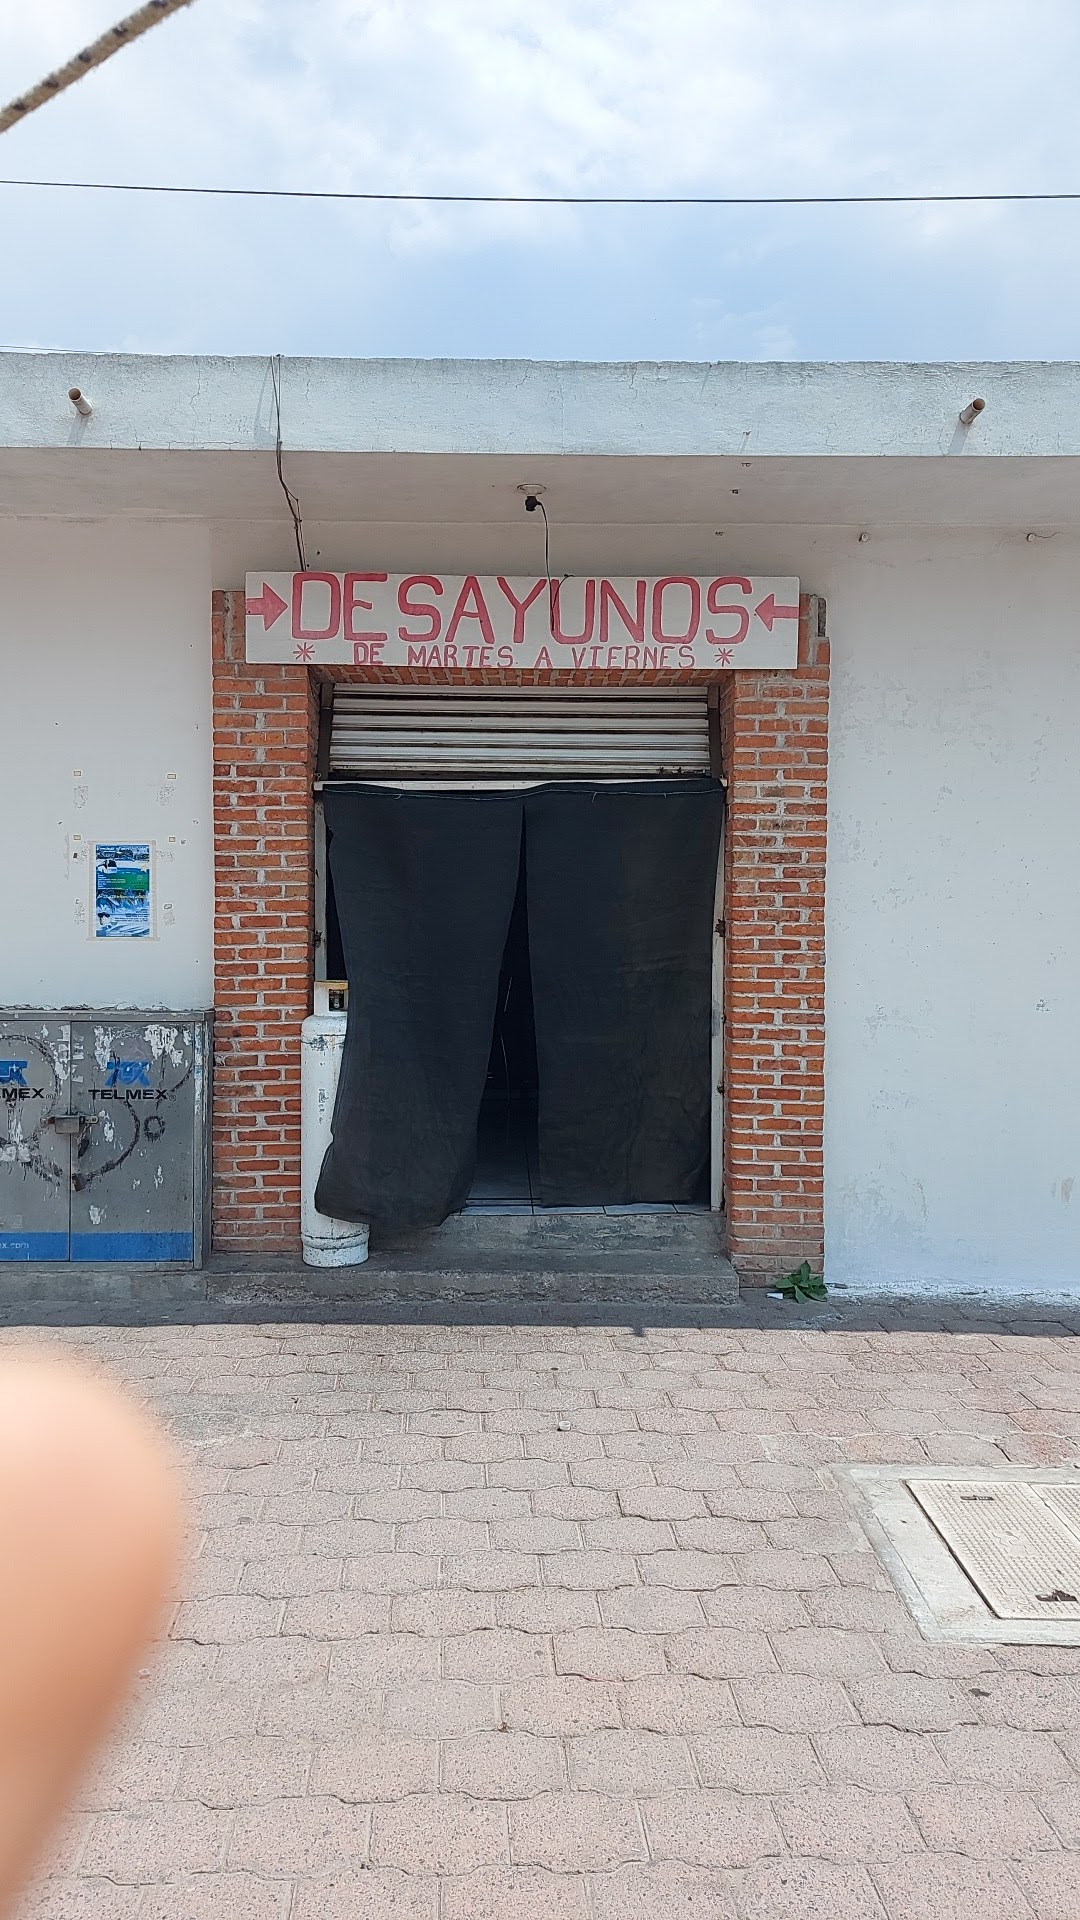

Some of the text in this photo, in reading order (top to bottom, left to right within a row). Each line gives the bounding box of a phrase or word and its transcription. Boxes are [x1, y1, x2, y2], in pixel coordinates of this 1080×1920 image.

[291, 572, 753, 645] DESAYUNOS
[353, 642, 695, 669] DE MARTES A VIERNES
[0, 1088, 45, 1099] MEX
[88, 1089, 168, 1100] TELMEX
